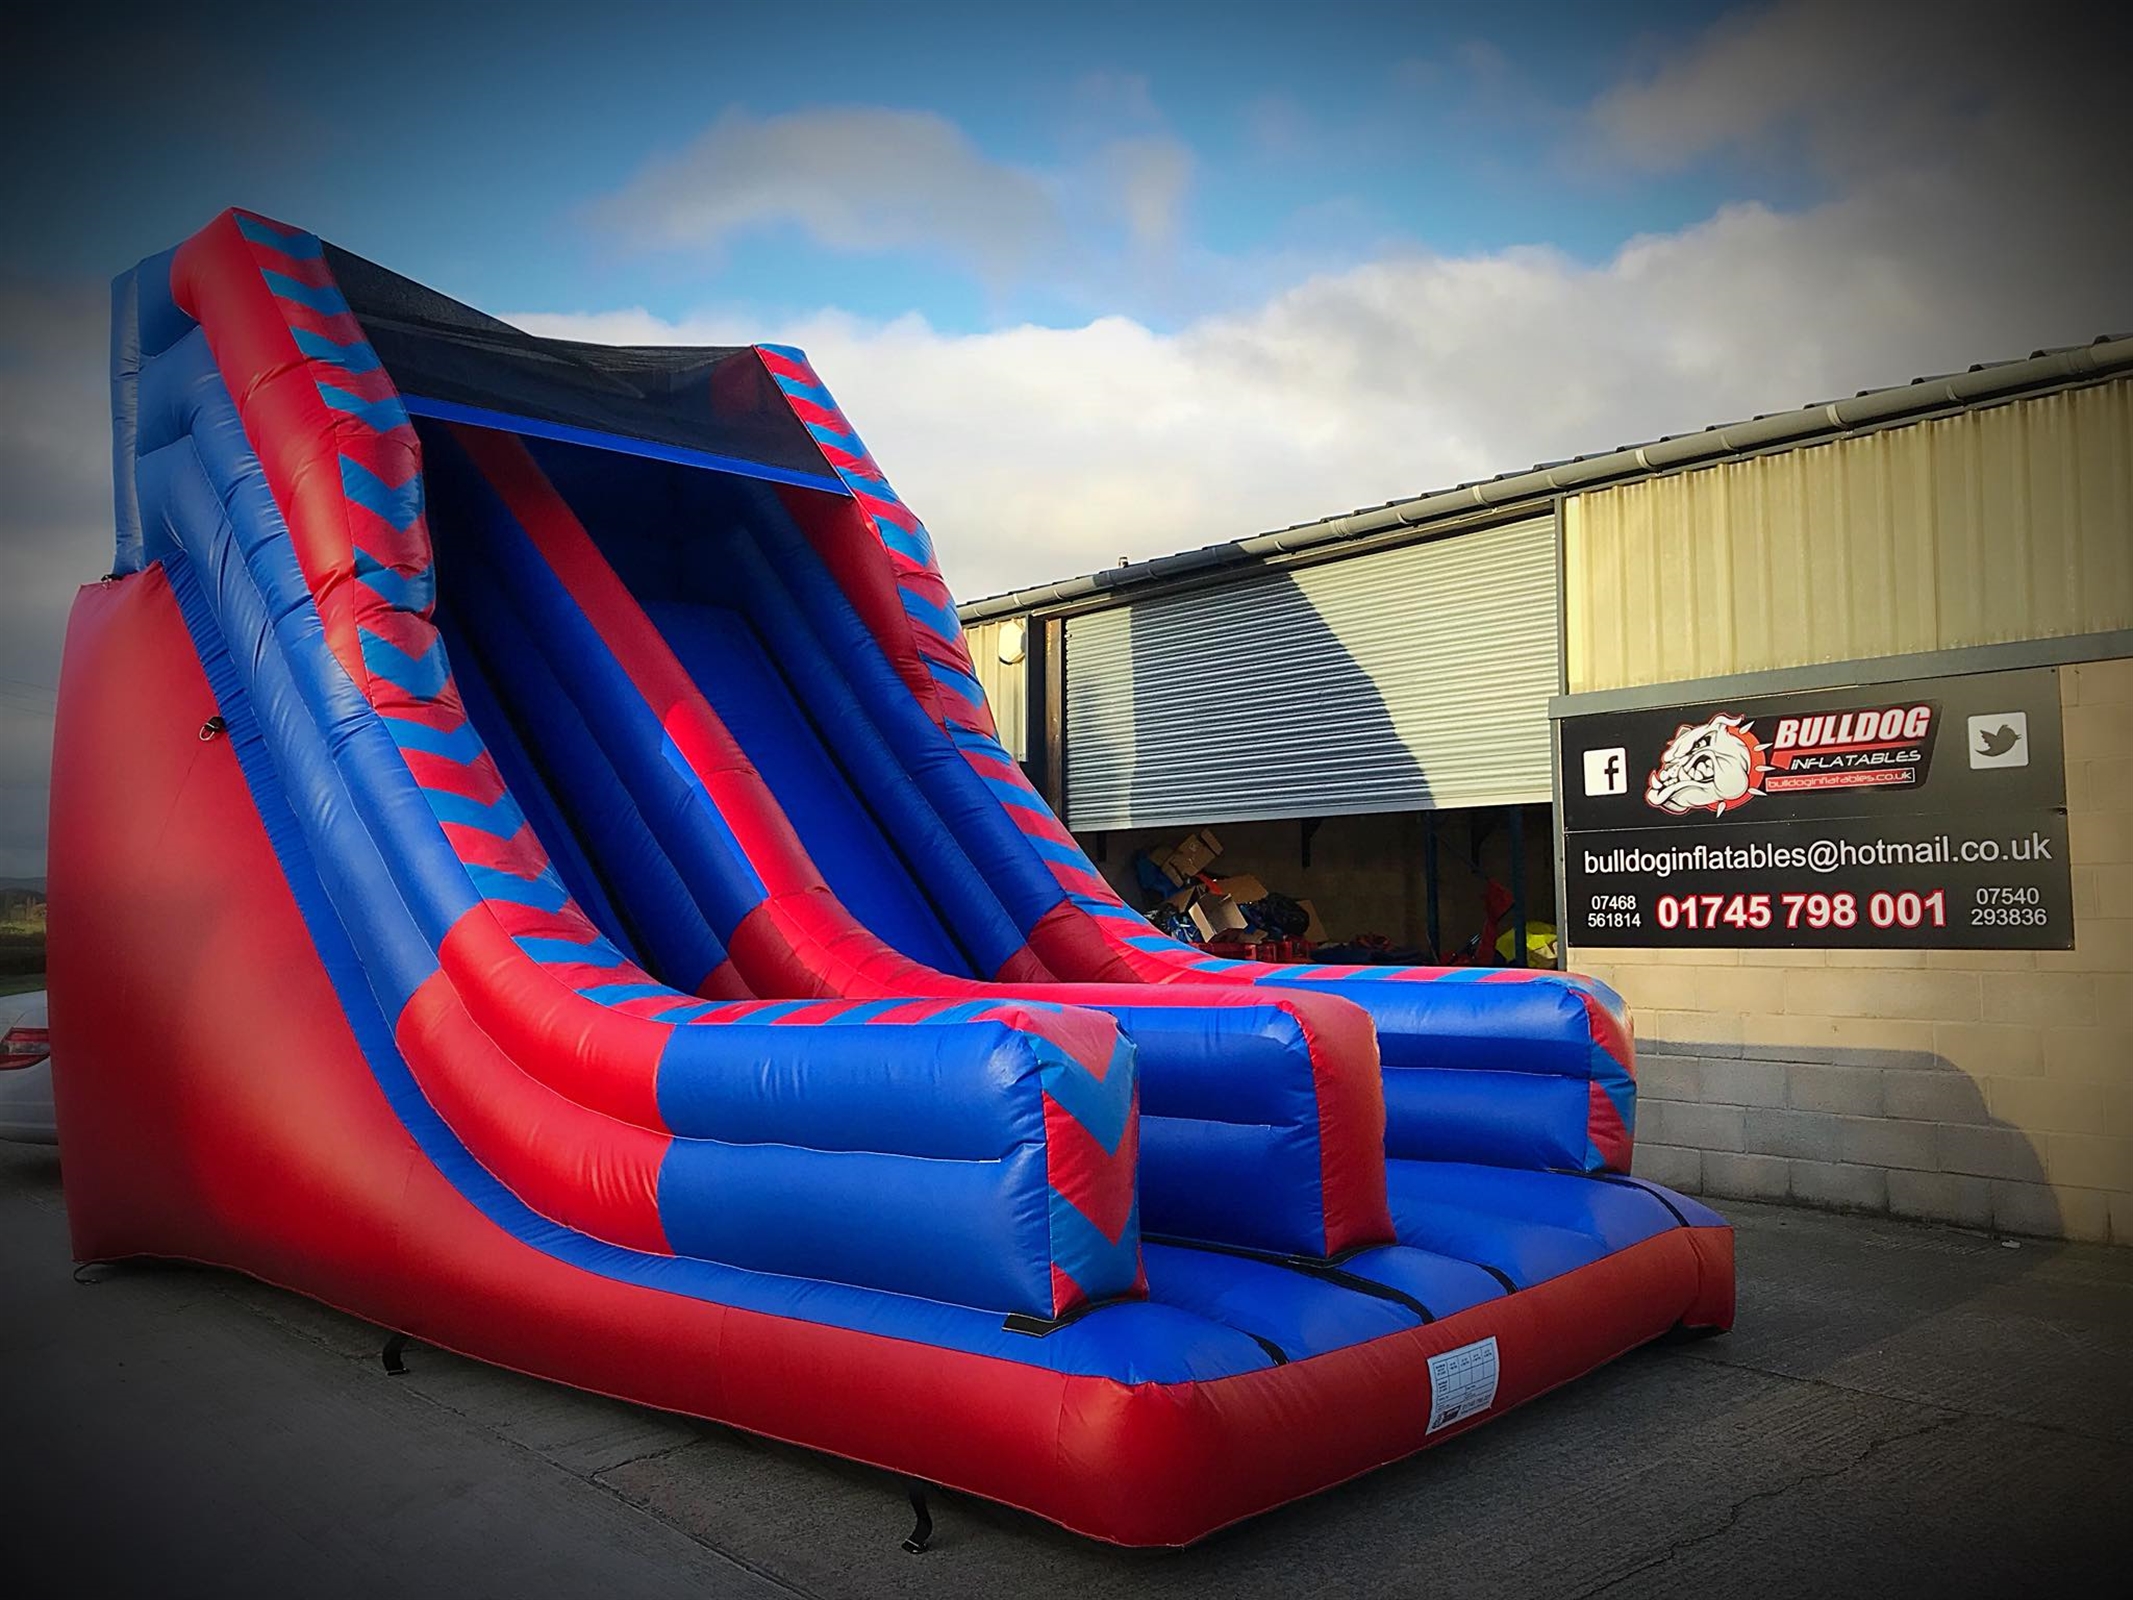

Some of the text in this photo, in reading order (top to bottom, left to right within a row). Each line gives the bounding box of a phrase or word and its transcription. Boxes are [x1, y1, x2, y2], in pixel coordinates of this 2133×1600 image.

[1773, 705, 1932, 750] BULLDOG
[1603, 754, 1620, 790] f
[1768, 770, 1912, 788] bulldoginflatables.co.uk
[1584, 832, 2052, 878] bulldoginflatables@hotmail.co.uk
[1591, 895, 1637, 910] 07468
[1976, 887, 2040, 905] 07540
[1657, 889, 1947, 930] 01745 798 001
[1971, 908, 2048, 926] 293836
[1587, 912, 1642, 928] 561814
